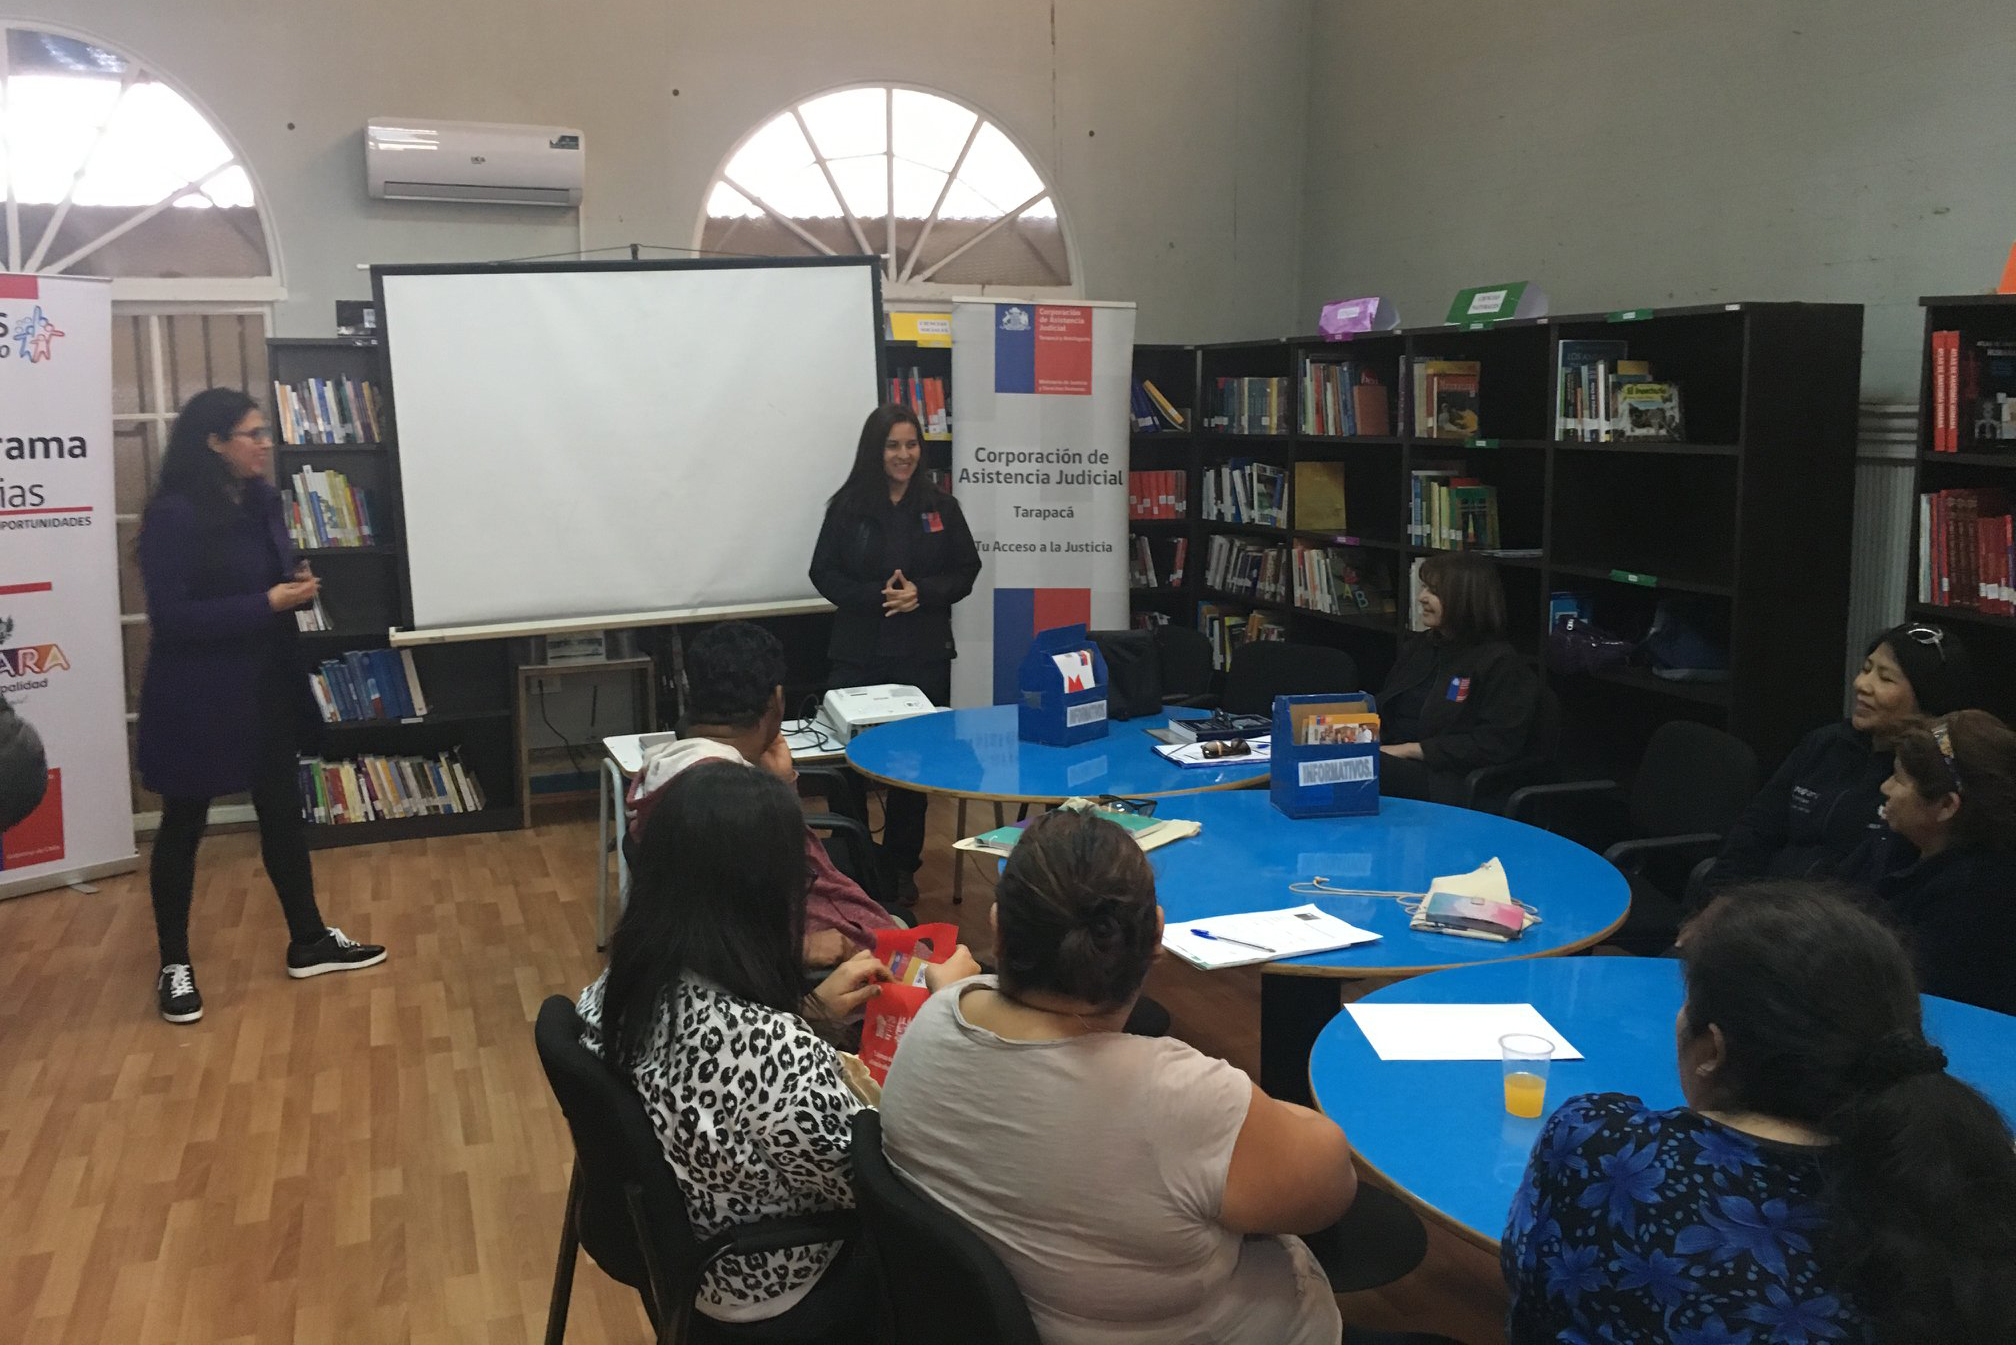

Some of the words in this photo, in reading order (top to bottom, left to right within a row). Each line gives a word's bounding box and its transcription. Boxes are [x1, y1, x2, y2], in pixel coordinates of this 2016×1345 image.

[0, 436, 86, 460] ama
[974, 447, 1083, 467] Corporación
[1087, 449, 1109, 465] de
[959, 468, 1050, 484] Asistencia
[1056, 470, 1123, 486] Judicial
[1013, 506, 1074, 520] Tarapacá
[993, 541, 1036, 552] Acceso
[1040, 544, 1047, 552] a
[1050, 542, 1061, 553] la
[1065, 542, 1112, 553] Justicia
